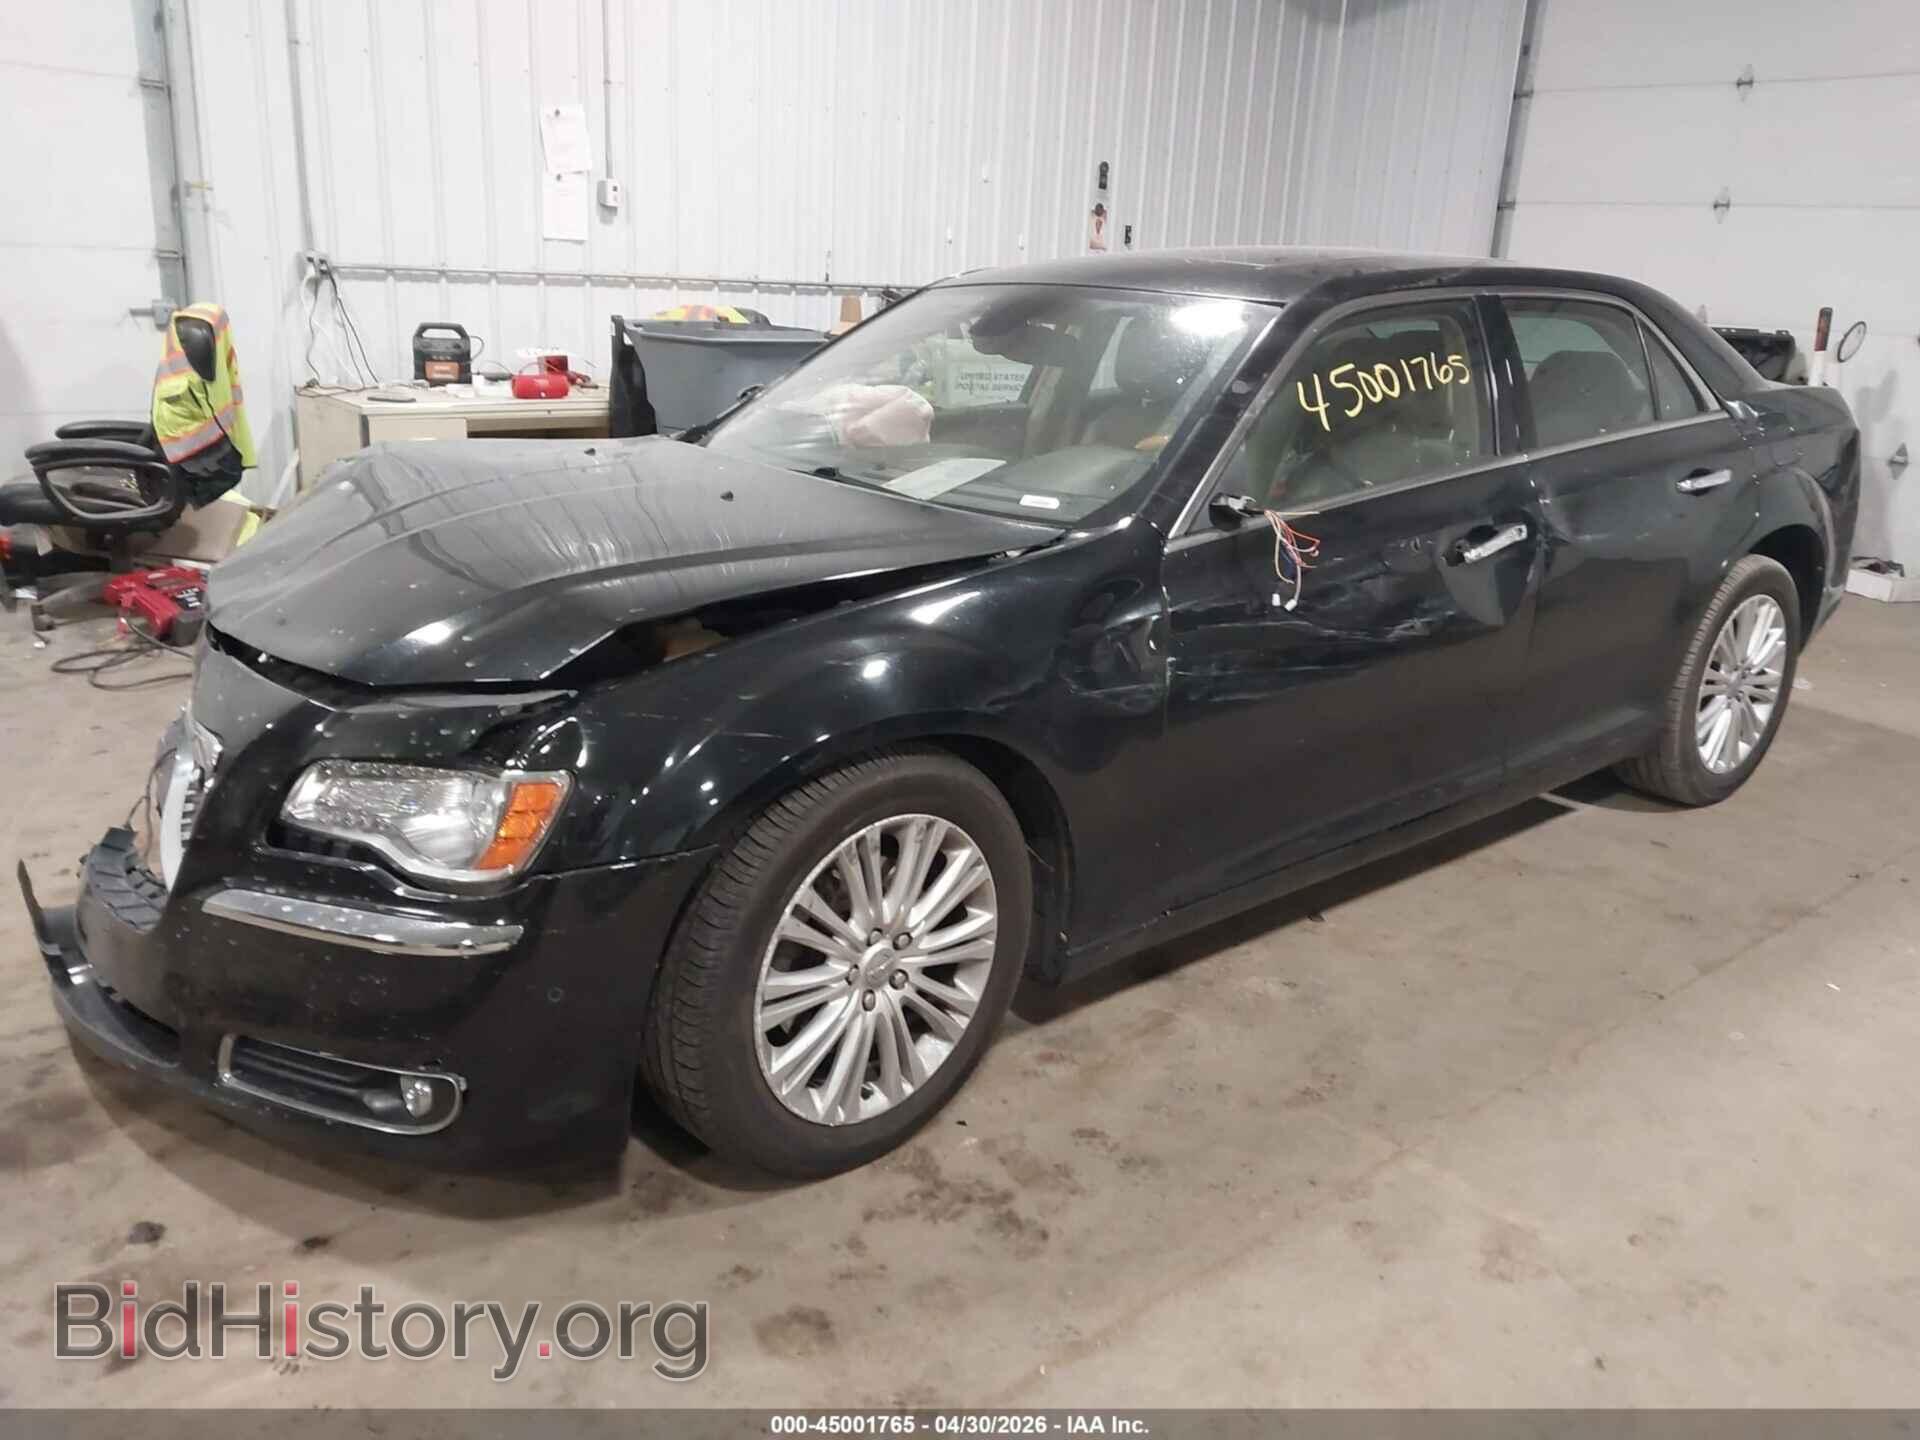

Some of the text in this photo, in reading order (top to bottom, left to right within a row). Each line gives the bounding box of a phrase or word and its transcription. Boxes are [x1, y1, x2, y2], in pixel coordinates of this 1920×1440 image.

[992, 373, 1025, 382] STATES
[992, 383, 1023, 392] SERVIC
[1297, 352, 1470, 432] 45001765
